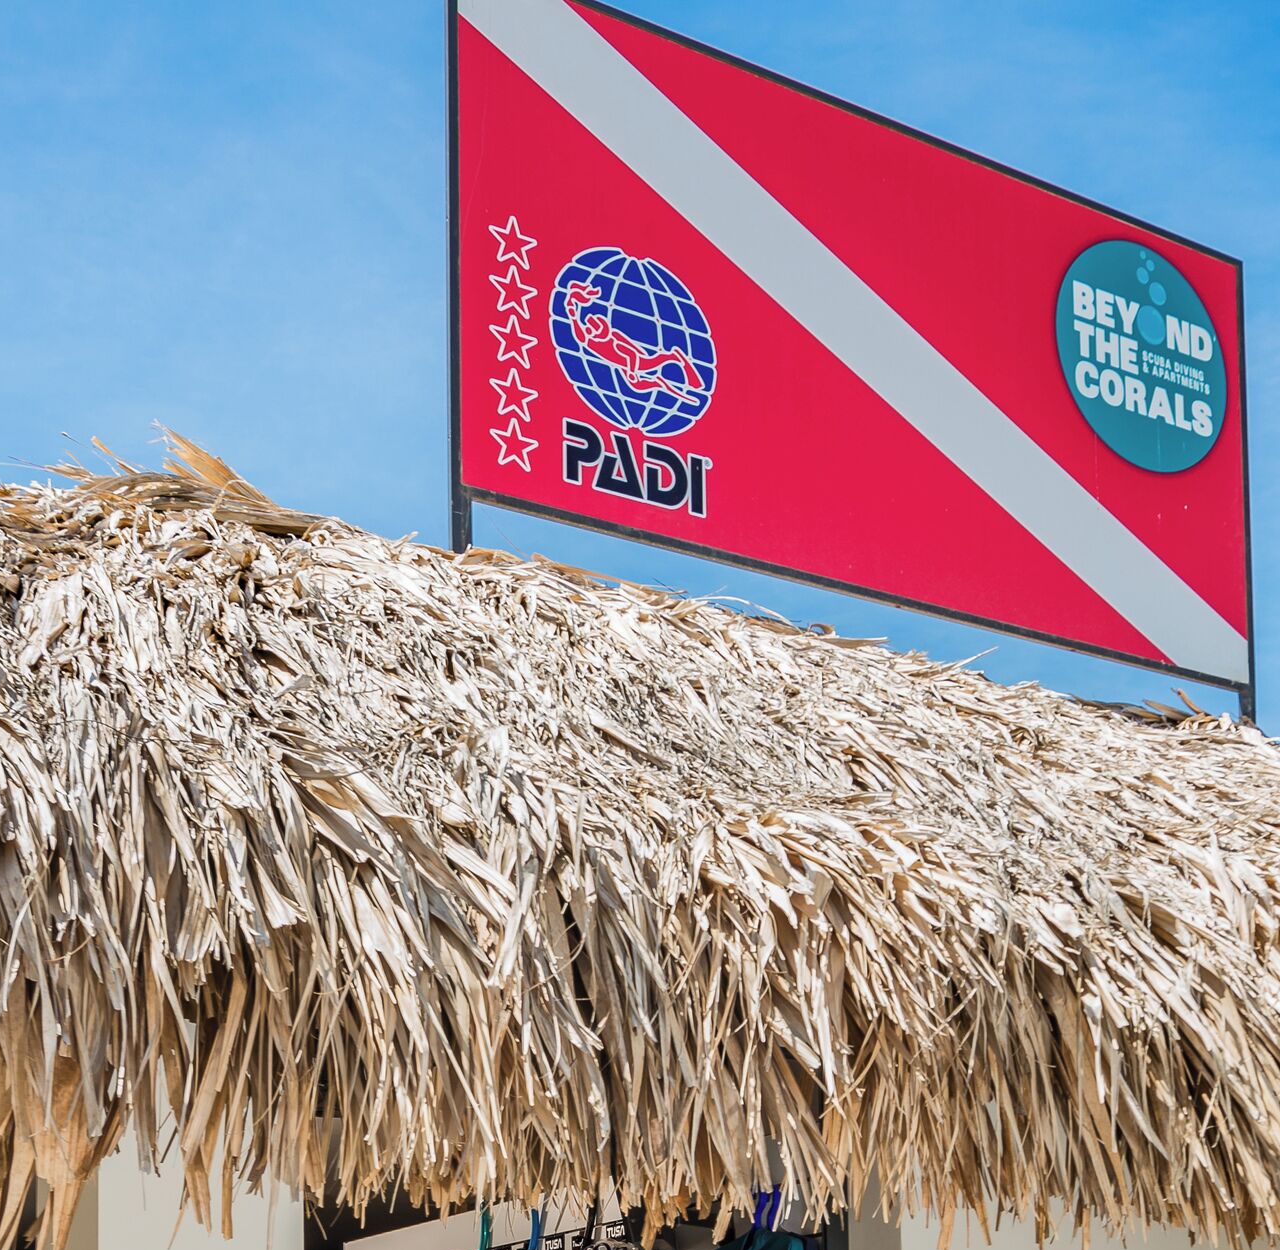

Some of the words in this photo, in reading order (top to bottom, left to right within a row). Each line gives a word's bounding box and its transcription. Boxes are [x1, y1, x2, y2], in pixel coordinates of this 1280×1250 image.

[1073, 319, 1140, 376] THE
[1141, 350, 1173, 371] SCUBA
[1173, 362, 1205, 382] DIVING
[1142, 361, 1150, 374] &
[1151, 366, 1211, 396] APARTMENTS
[1074, 360, 1214, 438] CORALS
[563, 418, 707, 518] PADI
[545, 1238, 563, 1250] TUSA
[606, 1224, 626, 1239] TUSA
